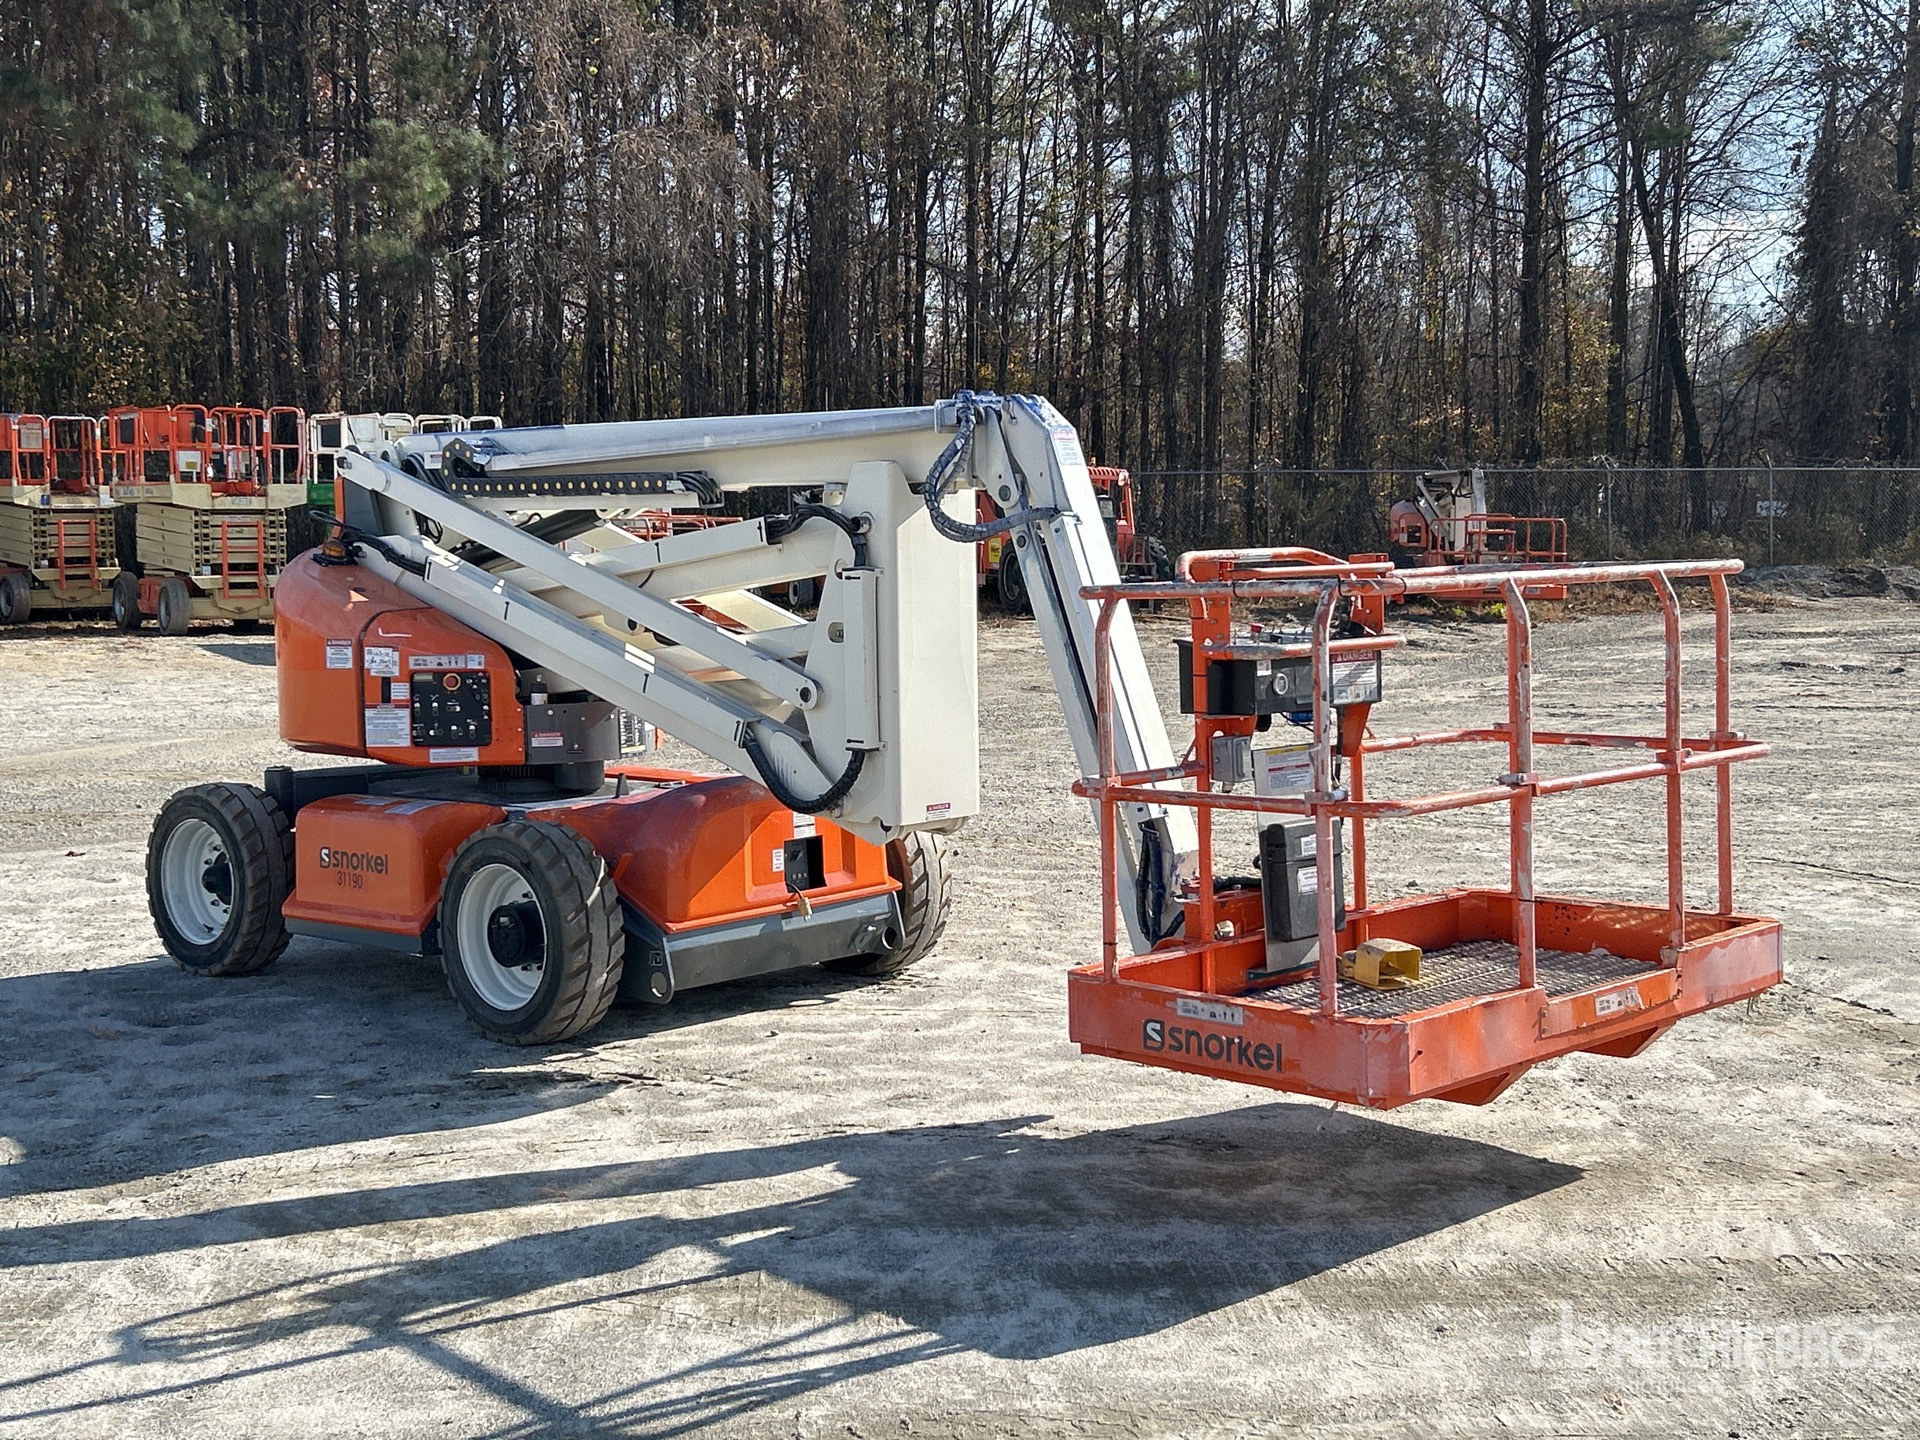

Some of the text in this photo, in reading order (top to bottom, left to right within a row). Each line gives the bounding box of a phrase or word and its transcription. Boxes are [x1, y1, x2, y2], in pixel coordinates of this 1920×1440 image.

[1342, 650, 1373, 661] DANGER
[332, 850, 388, 875] snorkel
[337, 870, 364, 889] 31190
[1168, 1026, 1283, 1073] snorkel
